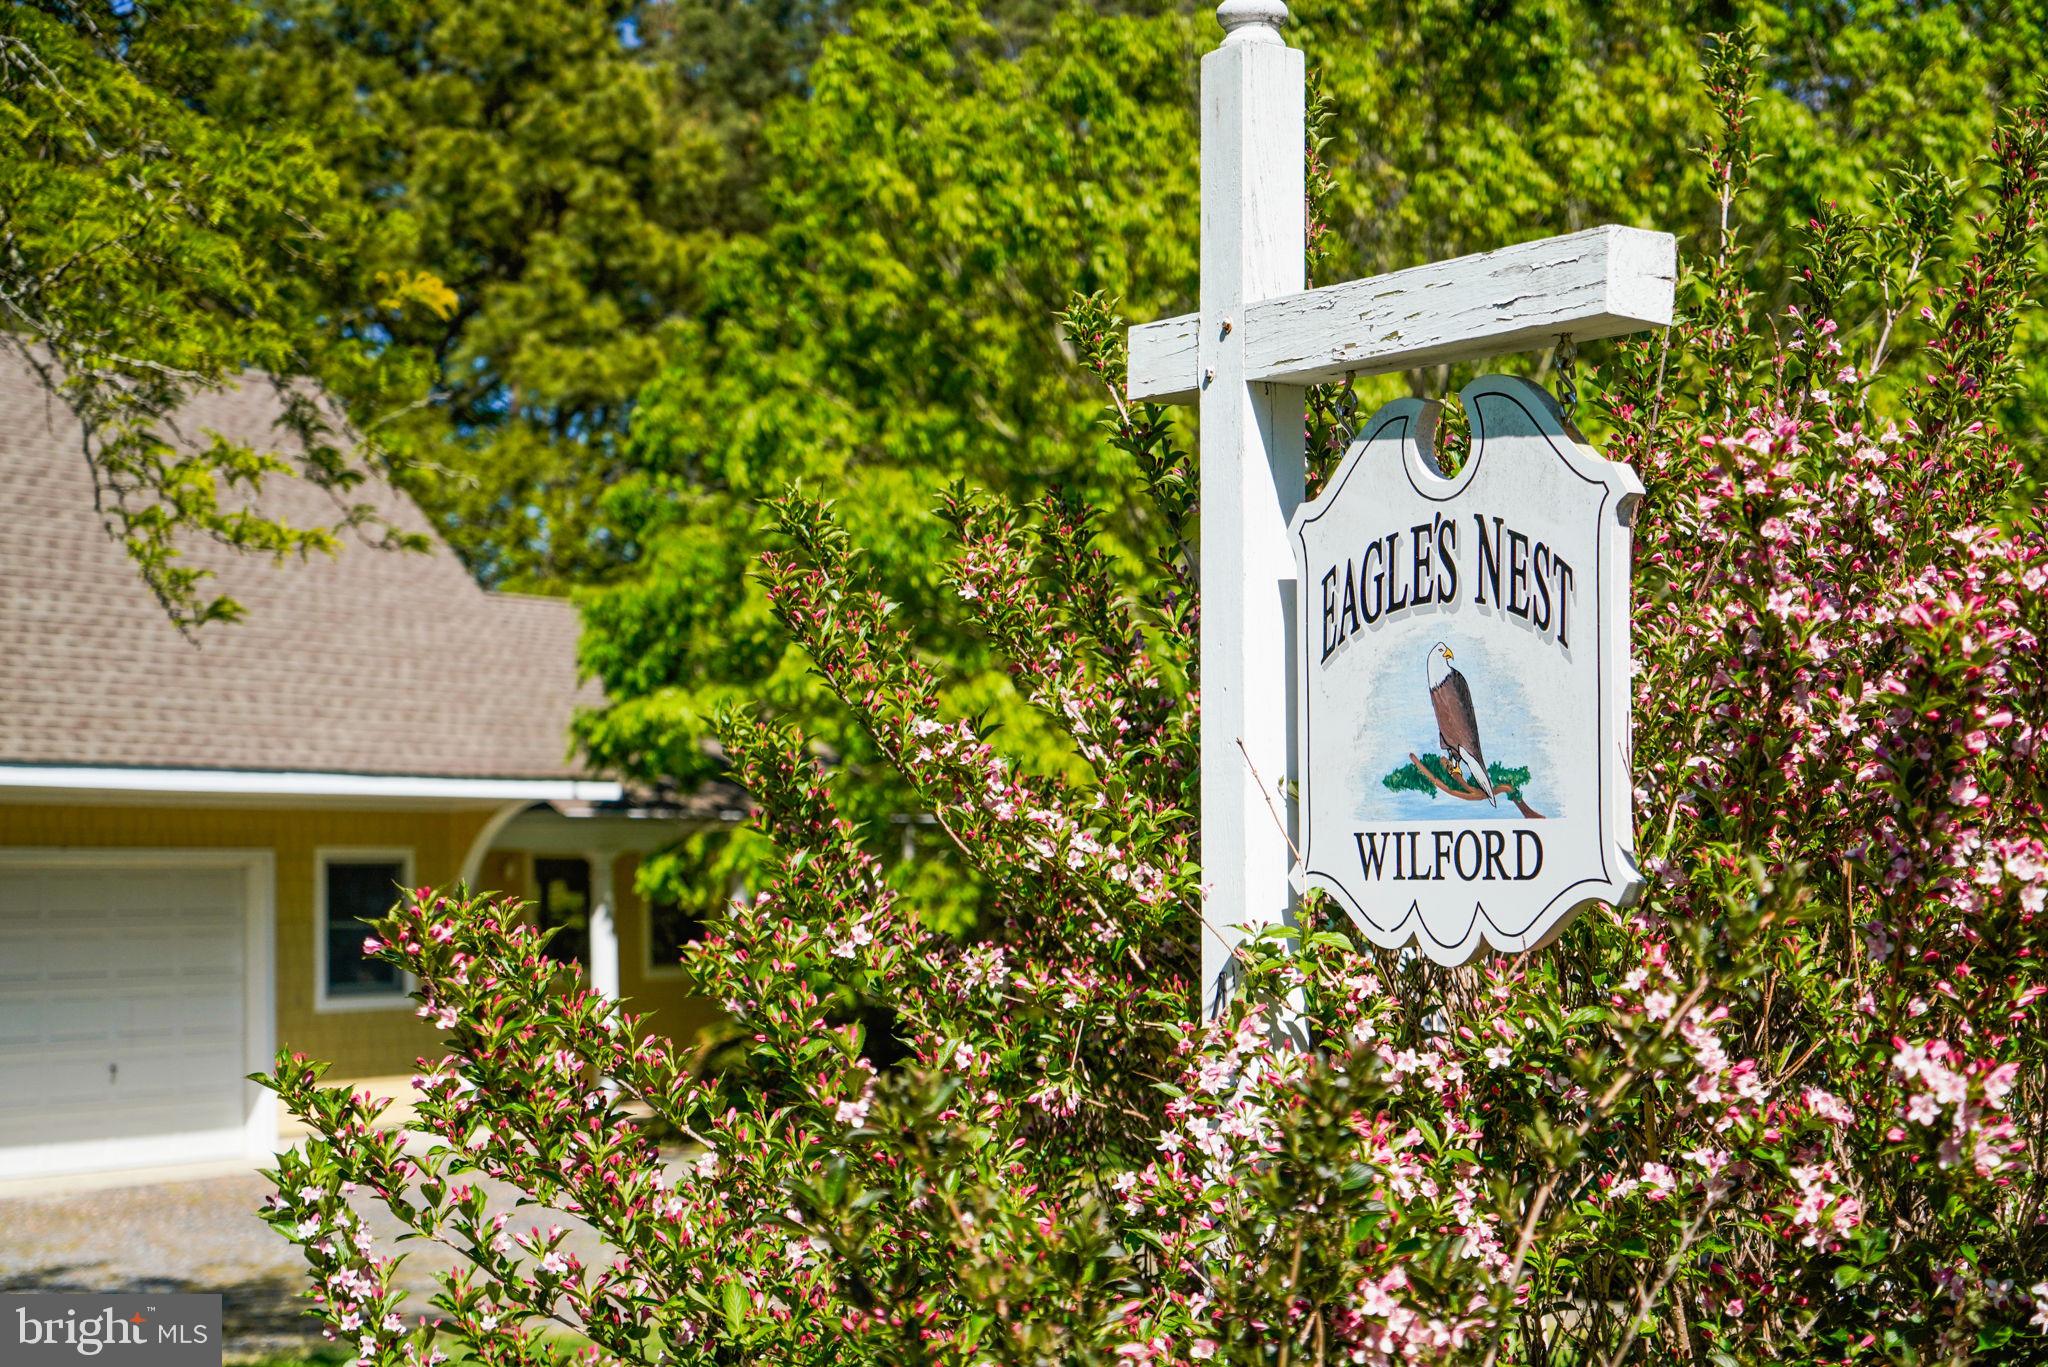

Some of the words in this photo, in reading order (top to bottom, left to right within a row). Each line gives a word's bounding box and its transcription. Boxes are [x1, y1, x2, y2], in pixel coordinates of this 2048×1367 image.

[1320, 511, 1458, 666] EAGLE'S
[1473, 513, 1574, 650] NEST
[1353, 829, 1544, 882] WILFORD
